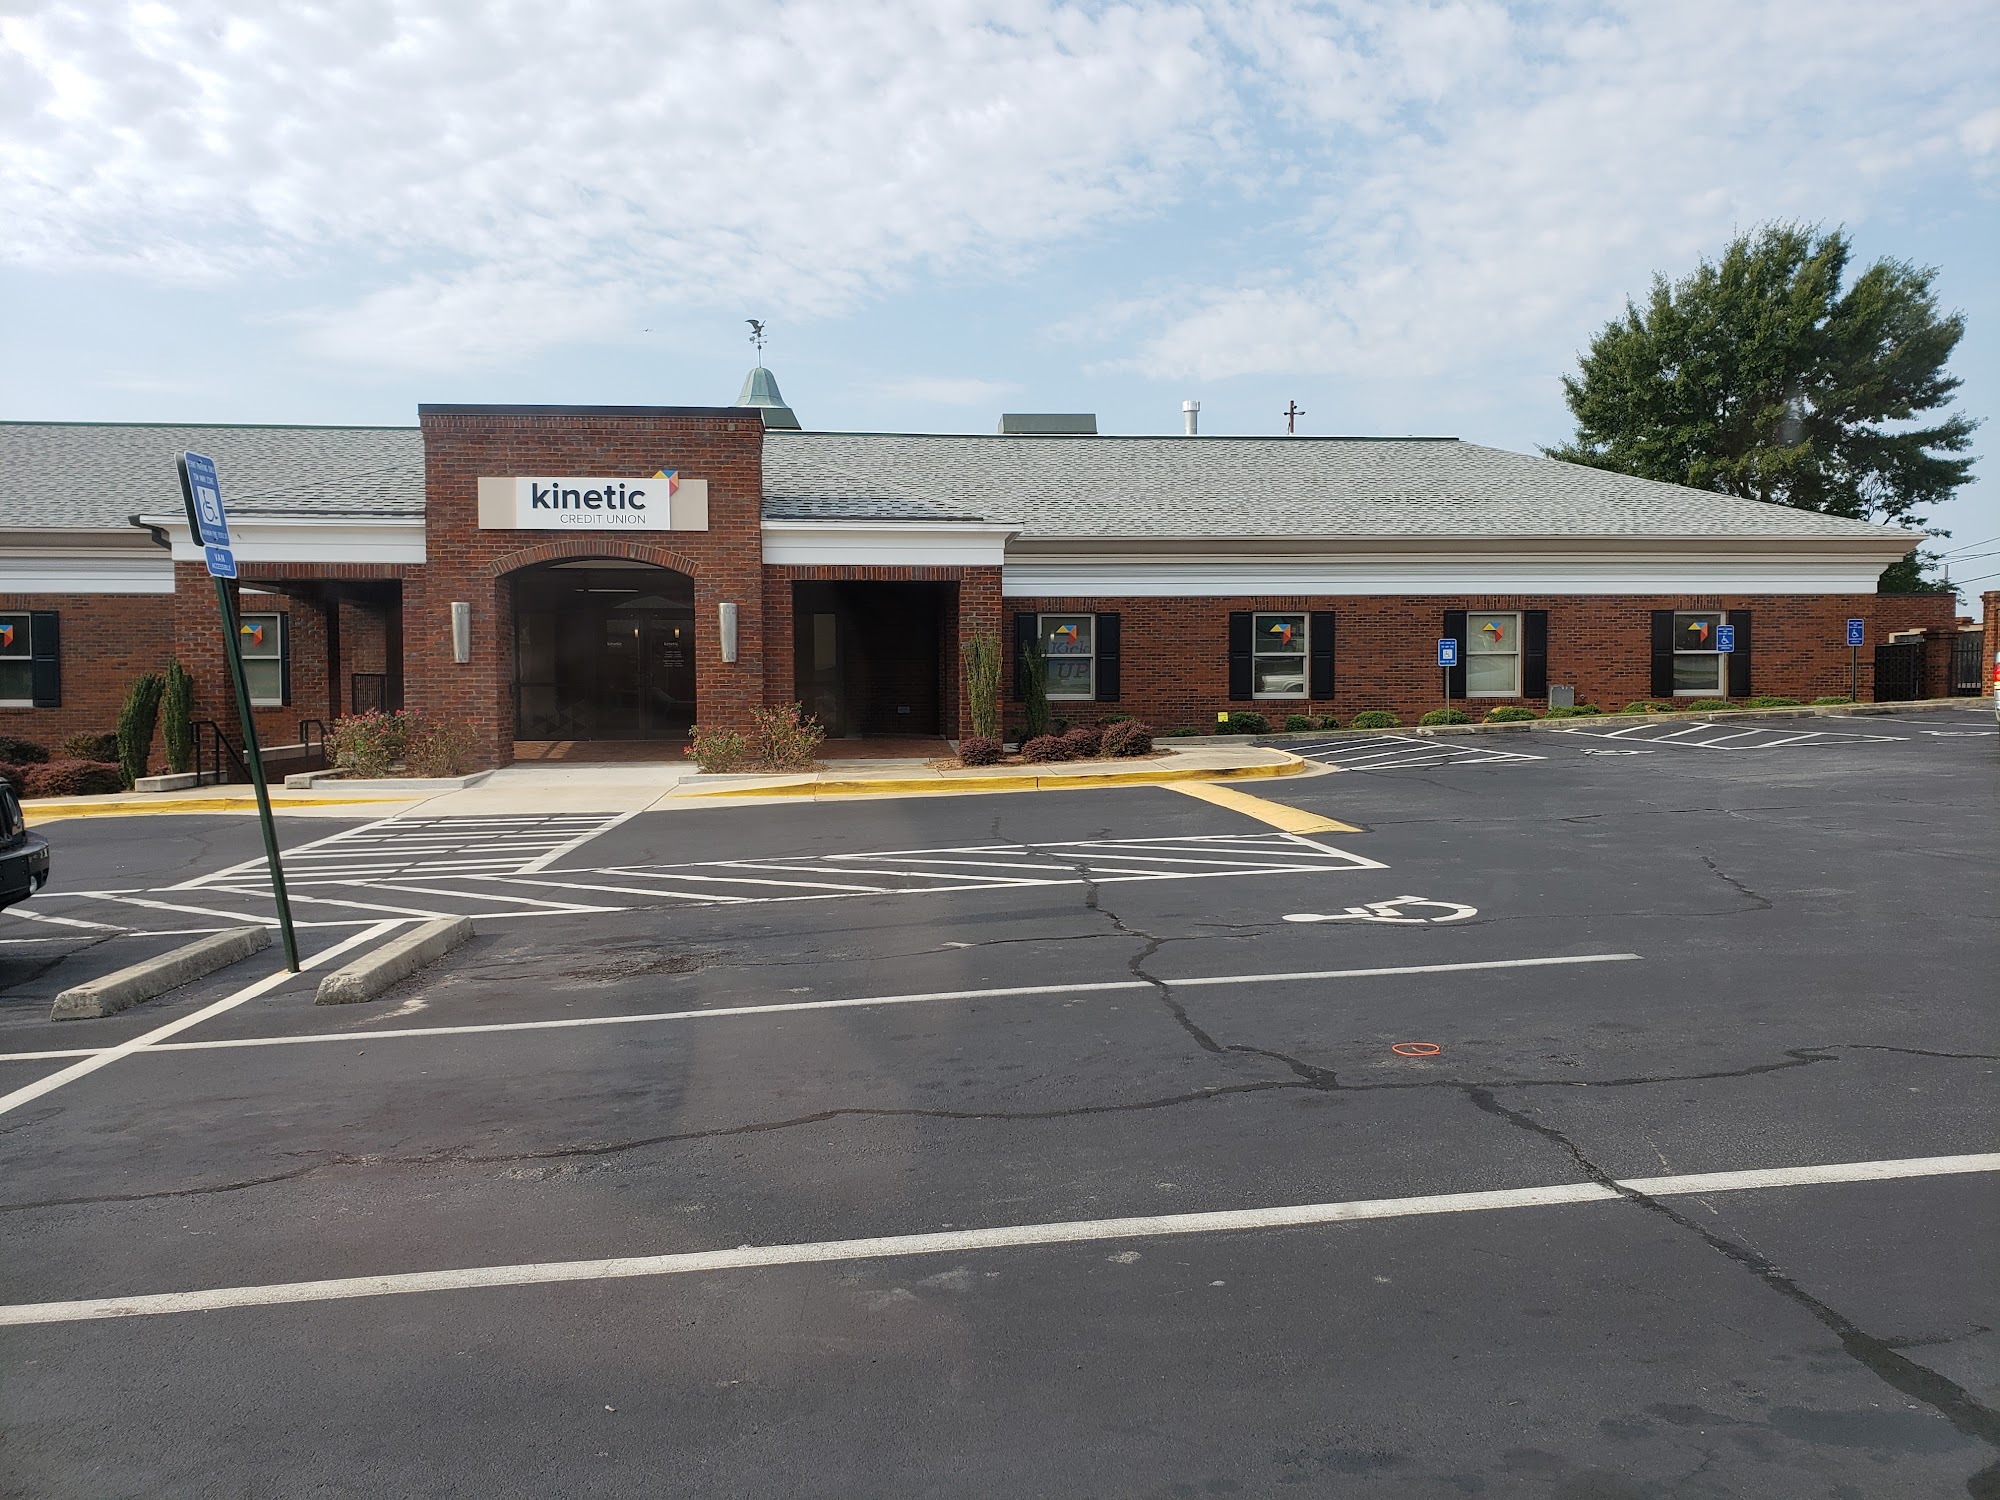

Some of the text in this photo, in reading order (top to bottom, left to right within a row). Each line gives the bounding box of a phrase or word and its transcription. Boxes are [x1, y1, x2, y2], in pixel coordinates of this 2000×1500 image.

[531, 482, 646, 510] kinetic
[560, 514, 646, 524] CREDIT UNION
